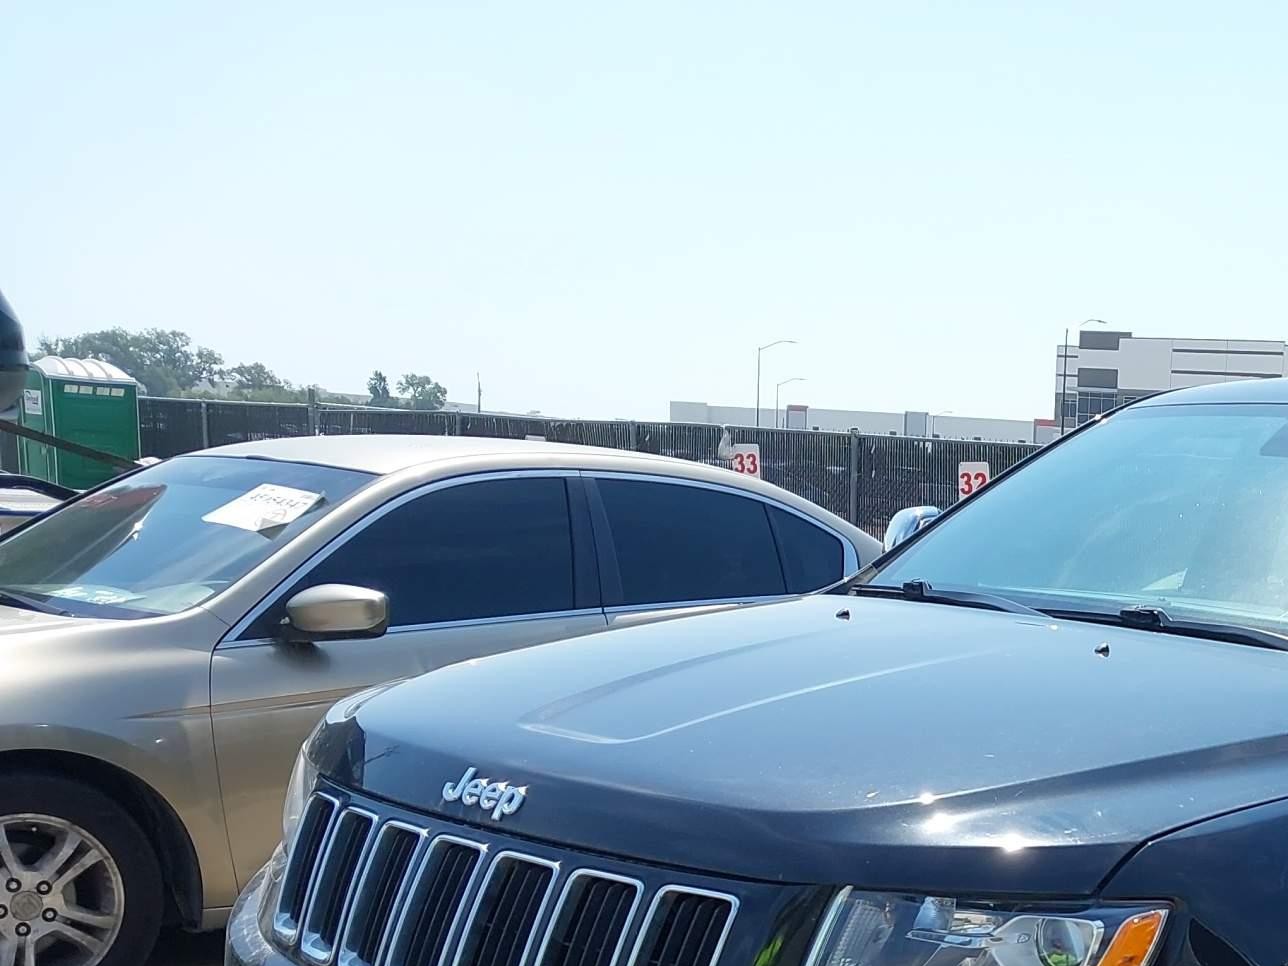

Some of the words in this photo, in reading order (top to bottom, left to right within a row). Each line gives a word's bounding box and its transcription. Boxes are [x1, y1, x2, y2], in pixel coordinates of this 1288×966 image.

[731, 453, 758, 475] 33
[960, 472, 987, 495] 32
[442, 766, 529, 821] Jeep
